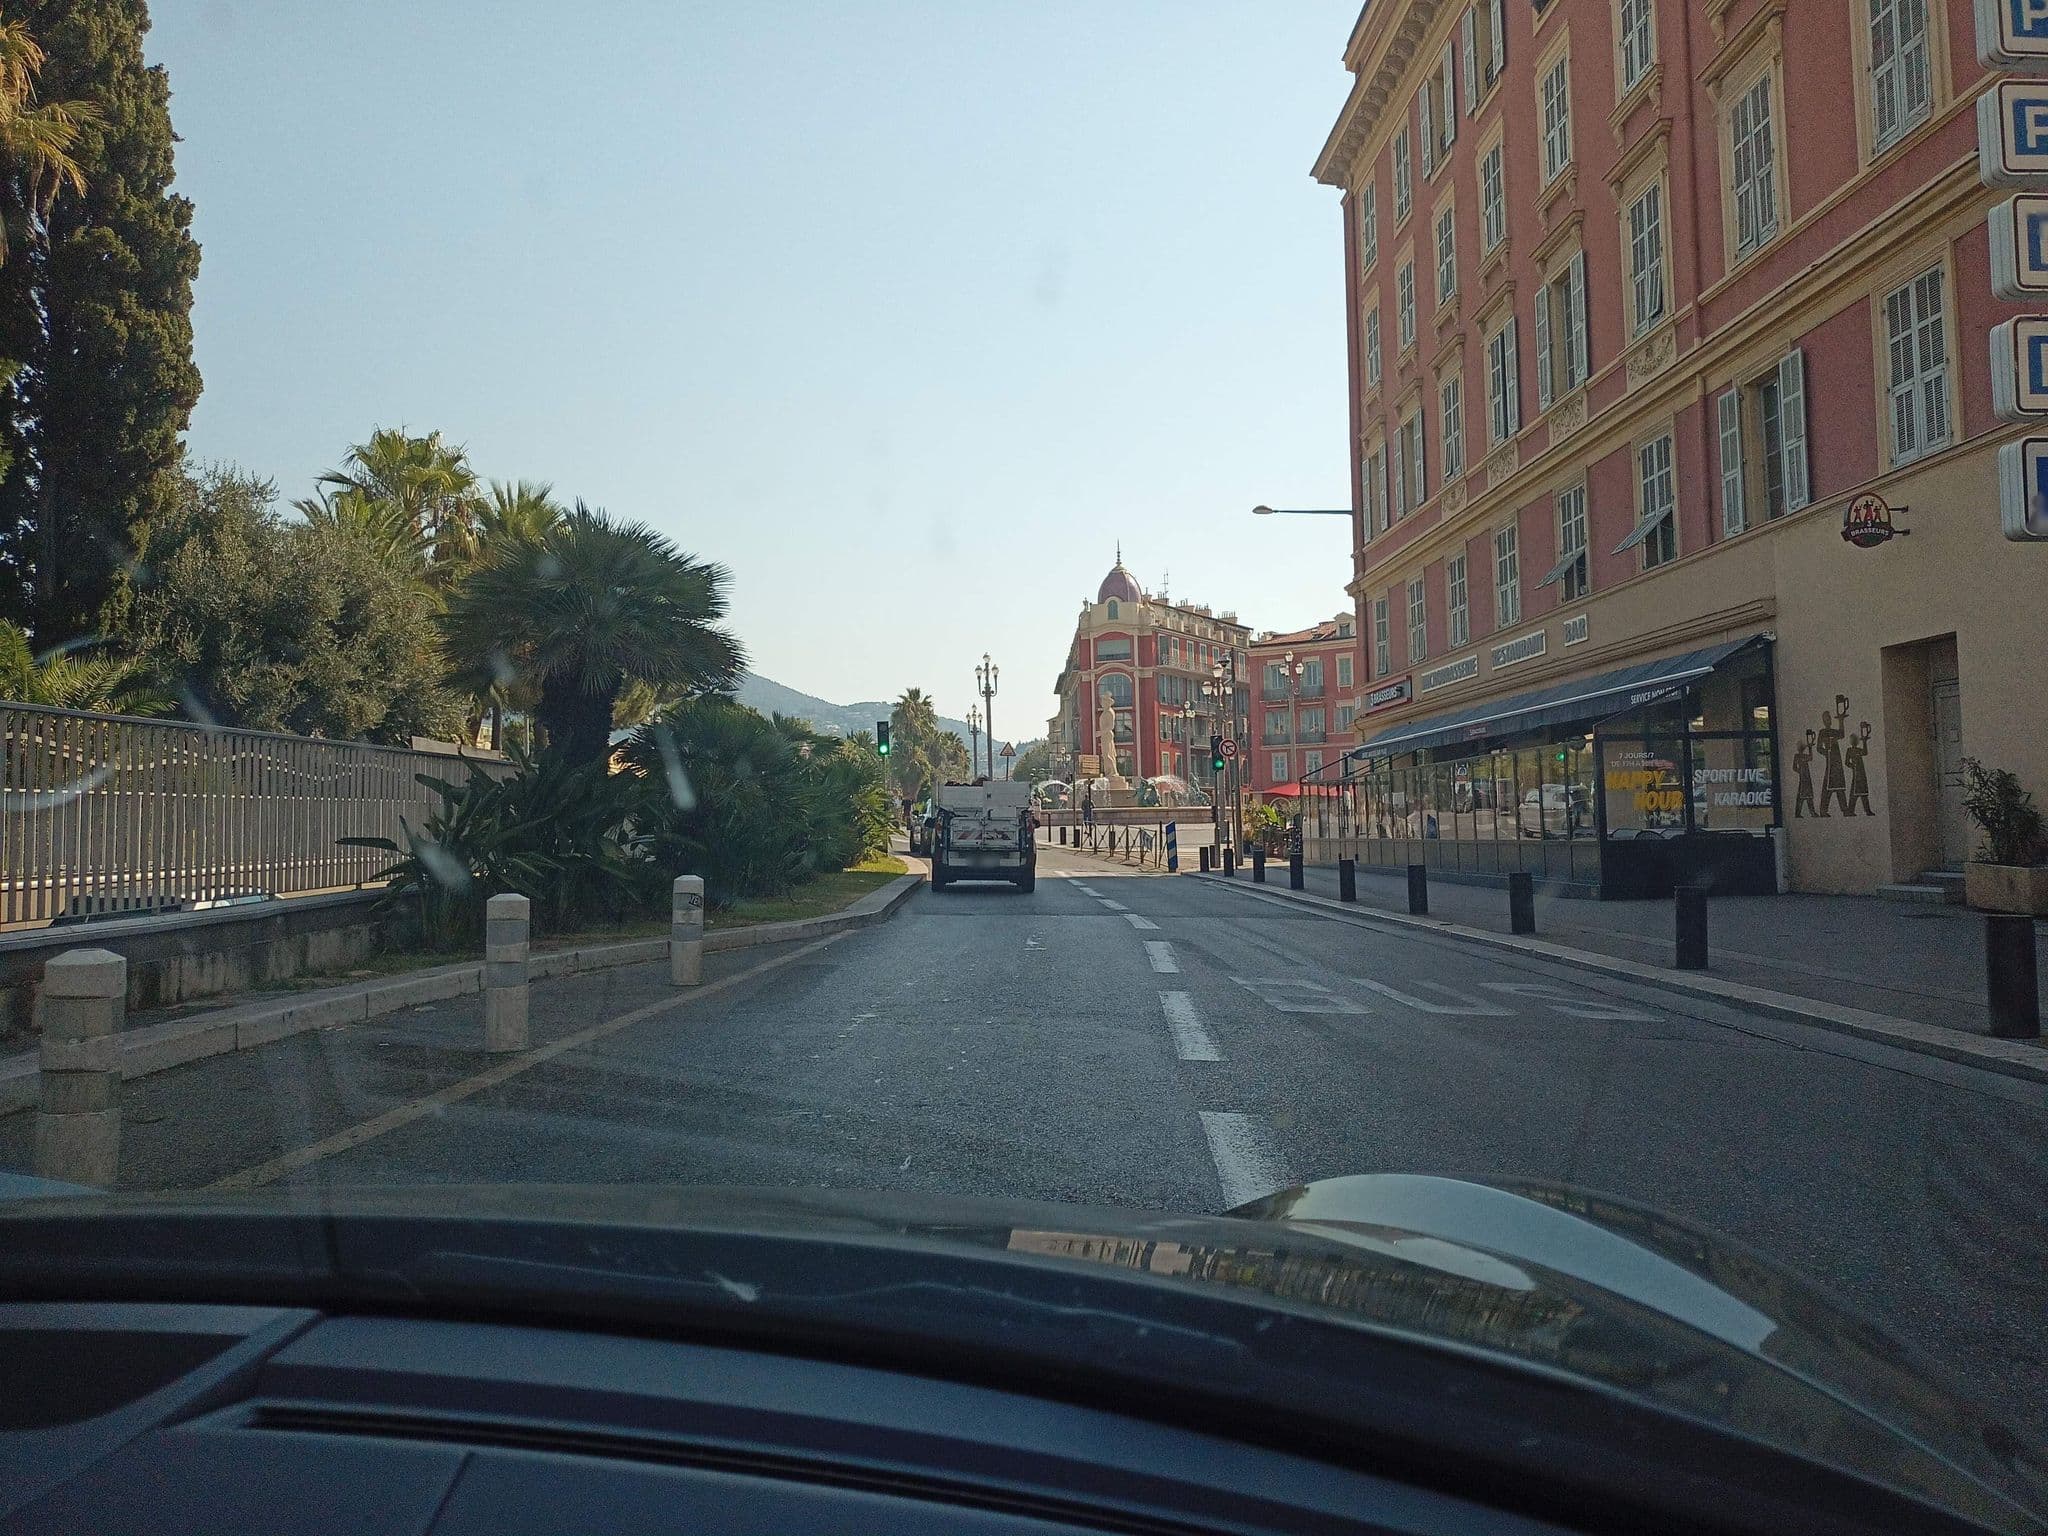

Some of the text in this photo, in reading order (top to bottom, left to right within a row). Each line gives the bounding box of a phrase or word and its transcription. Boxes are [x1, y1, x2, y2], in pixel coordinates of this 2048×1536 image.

[1850, 527, 1889, 537] BRASSEURS
[1564, 617, 1587, 643] BAR
[1492, 632, 1545, 668] RESTAURANT
[1374, 686, 1397, 705] BRASSEURS
[1630, 691, 1651, 705] SERVICE
[1606, 770, 1666, 790] HAPPY
[1694, 767, 1767, 784] SPORT LIVE
[1632, 790, 1684, 811] HOUR
[1228, 976, 1666, 1022] BUS
